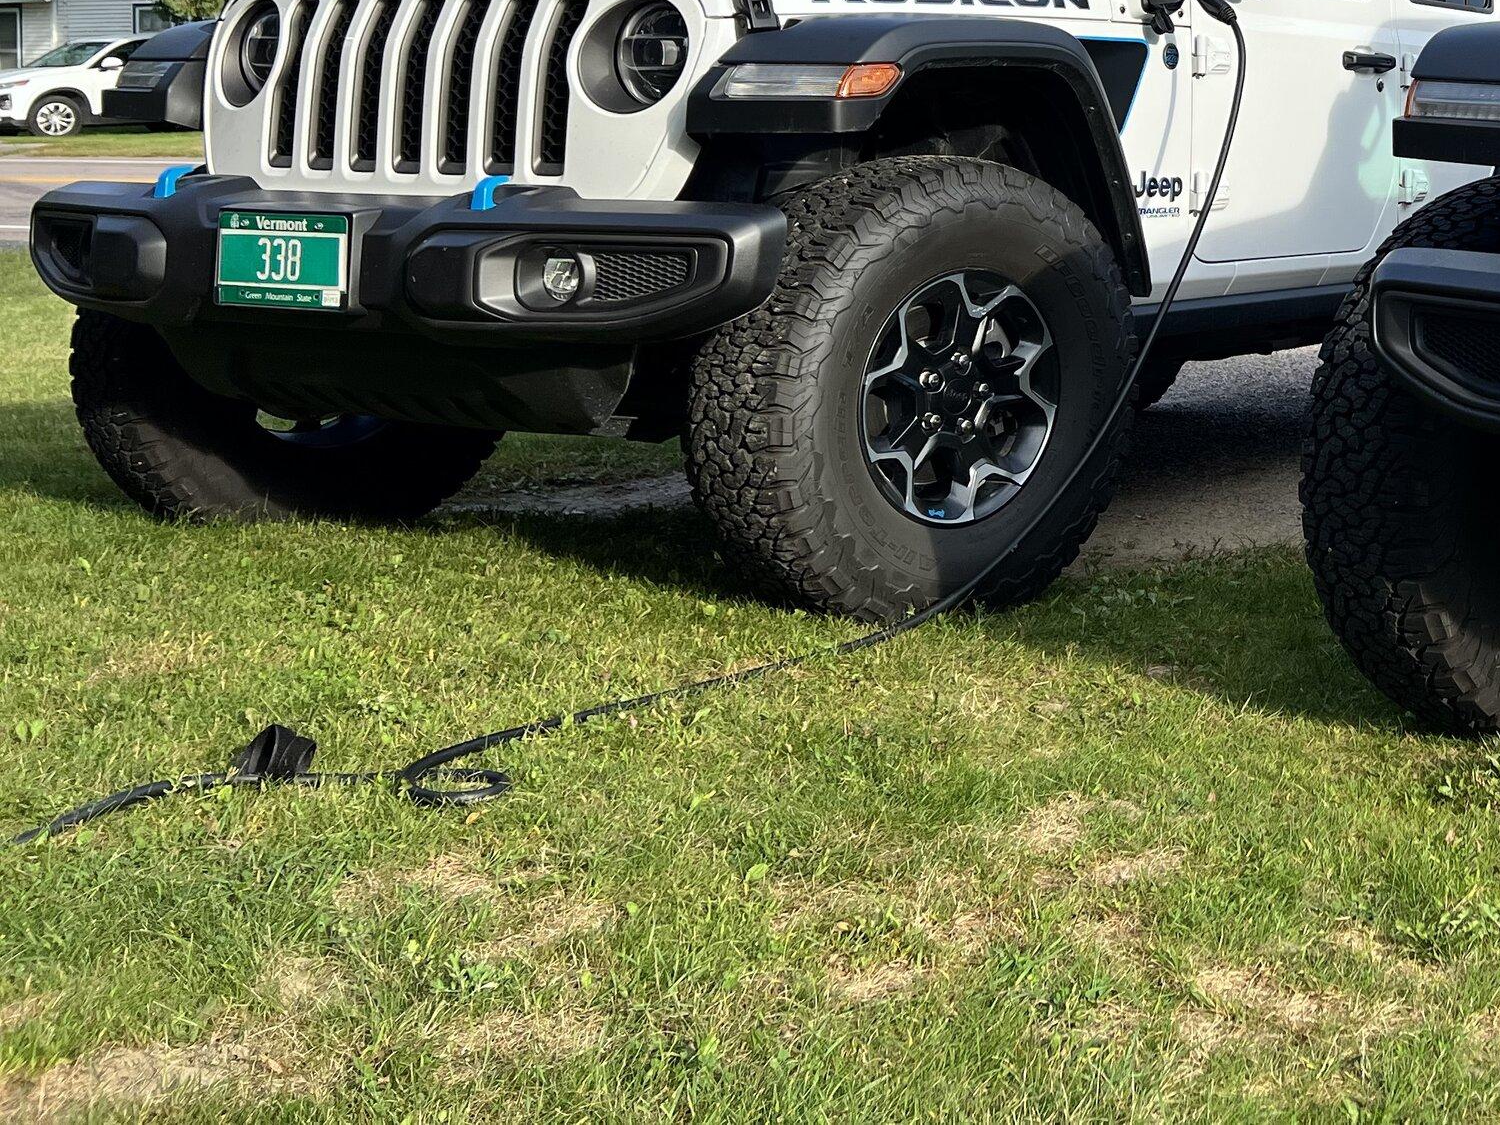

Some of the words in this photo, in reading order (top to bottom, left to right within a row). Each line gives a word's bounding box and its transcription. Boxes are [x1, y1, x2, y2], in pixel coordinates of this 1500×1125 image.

[1132, 171, 1182, 202] Jeep
[255, 216, 307, 231] Vermont
[256, 237, 302, 281] 338
[244, 291, 262, 300] Green
[265, 292, 293, 302] Mountain
[296, 294, 312, 303] State
